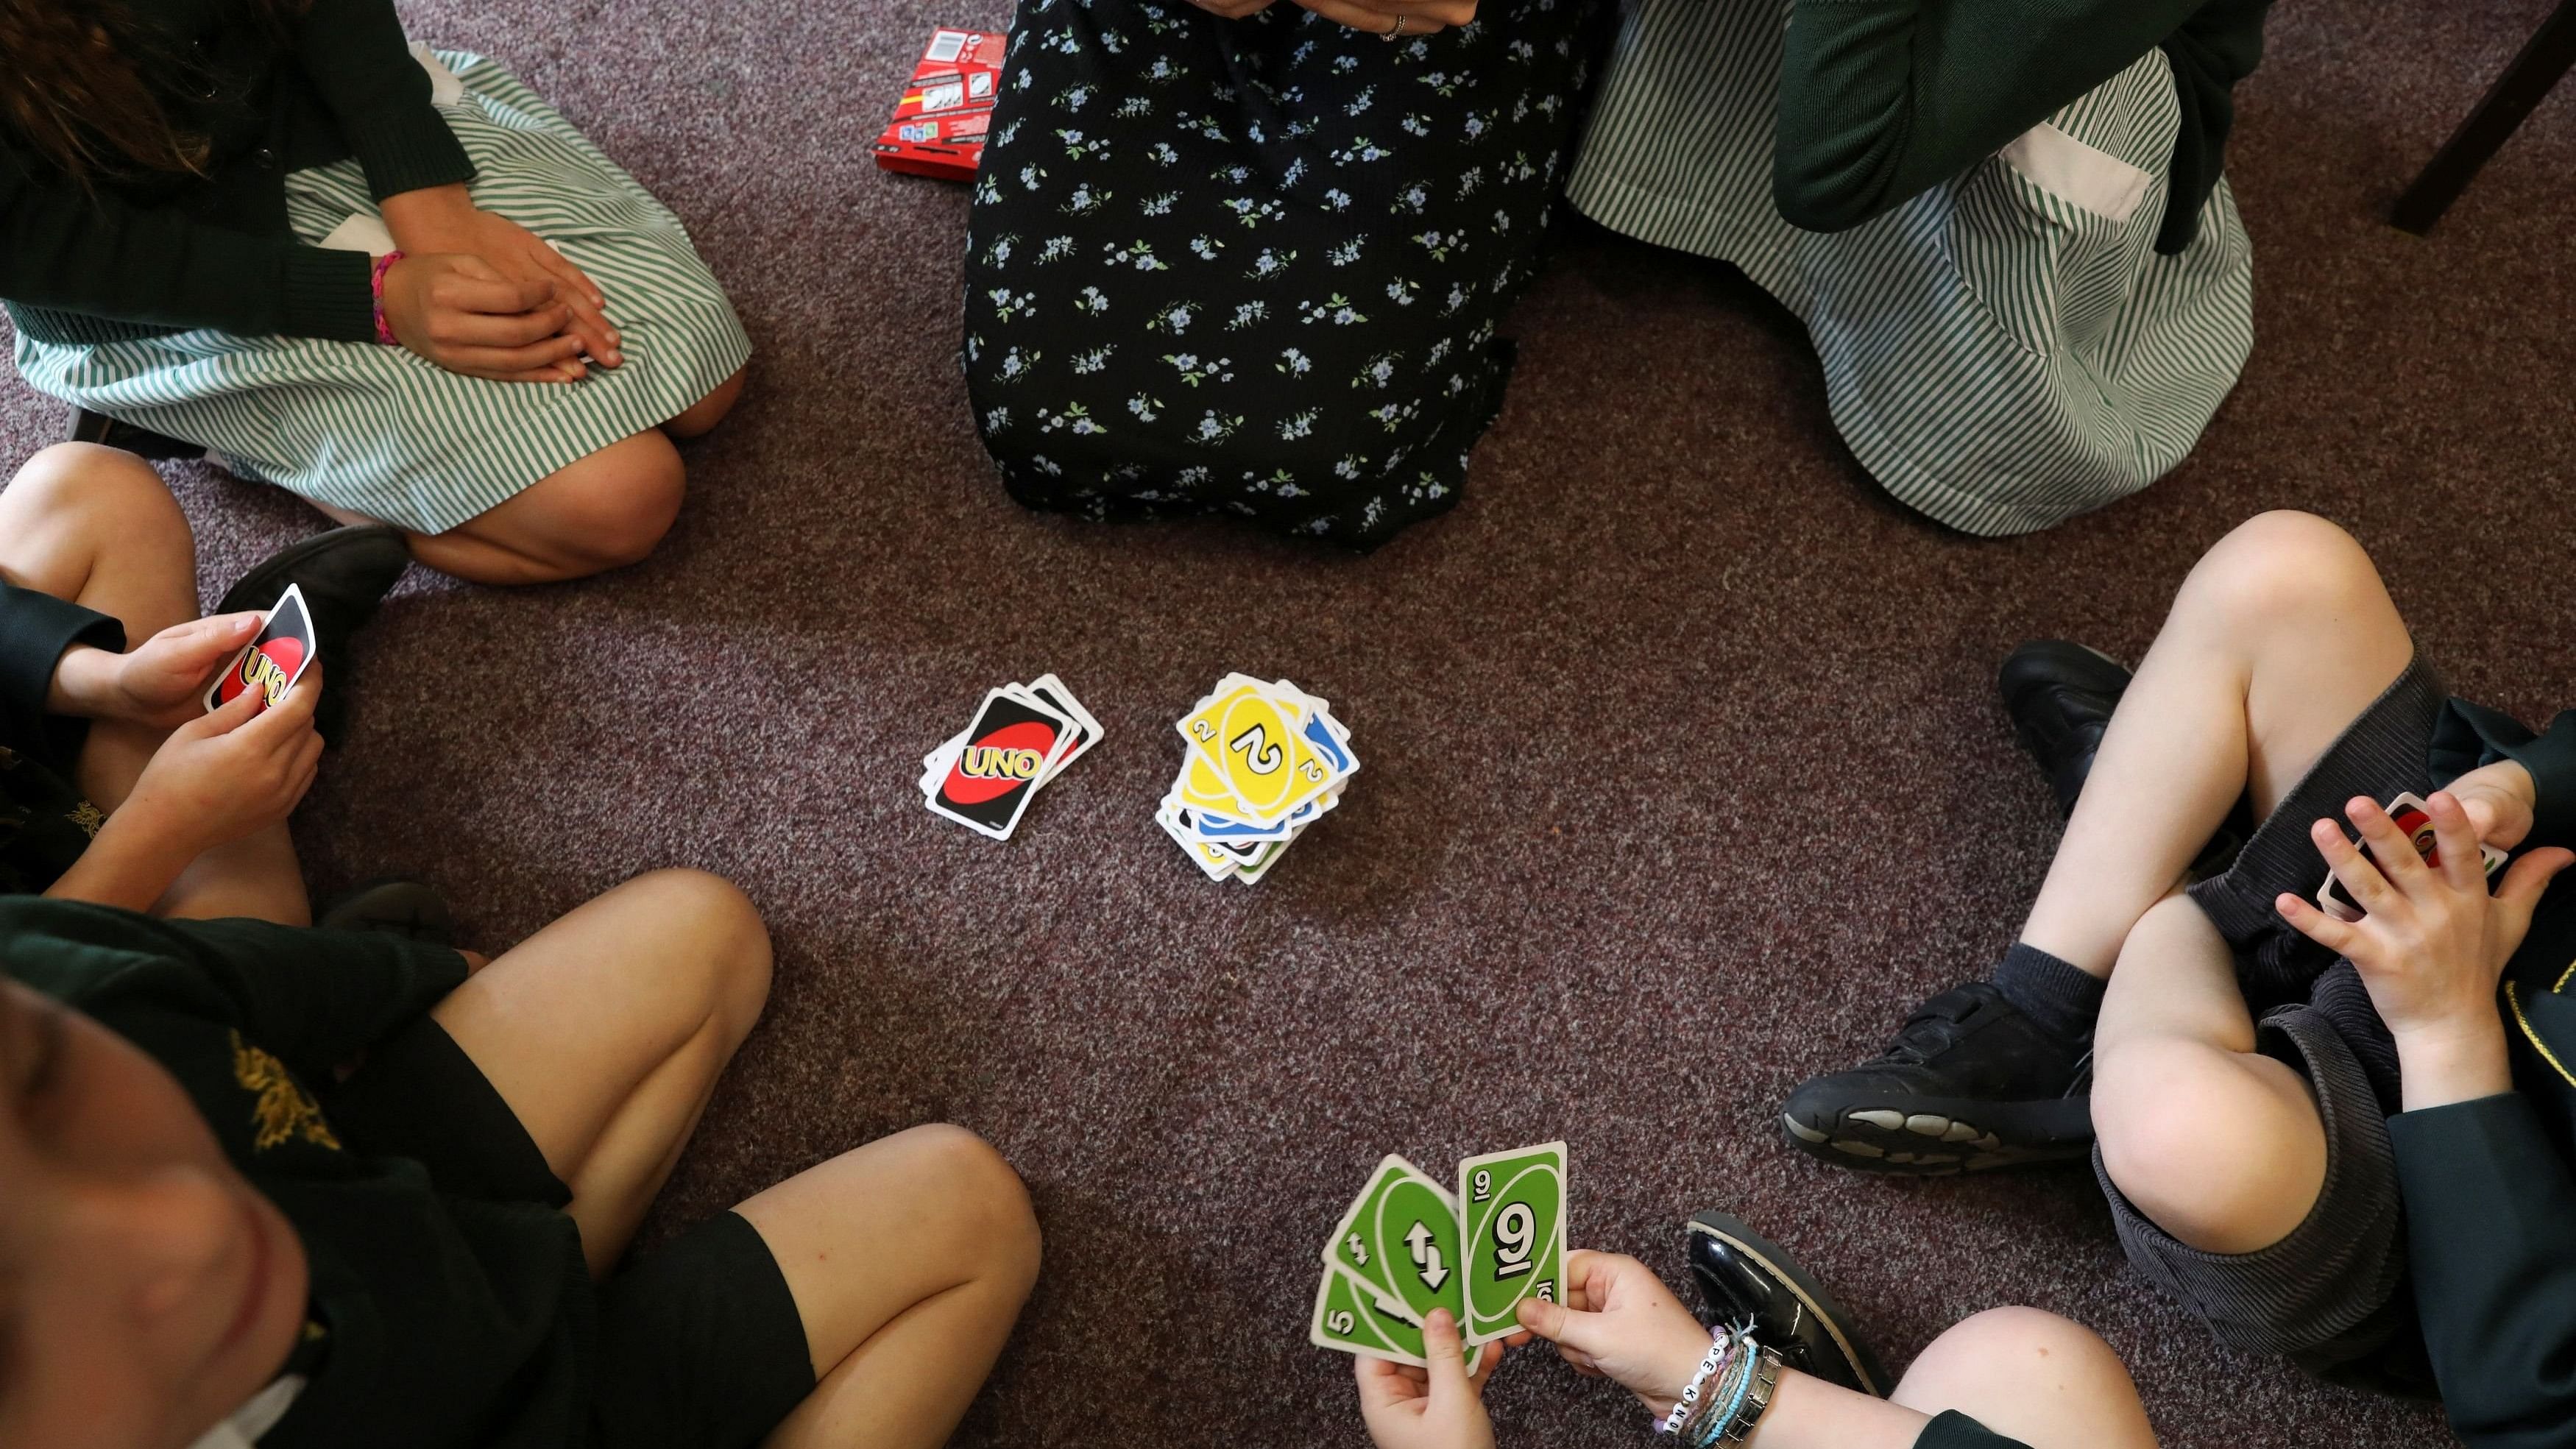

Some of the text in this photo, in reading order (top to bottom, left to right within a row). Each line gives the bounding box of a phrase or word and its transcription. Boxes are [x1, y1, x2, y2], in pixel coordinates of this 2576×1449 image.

[241, 646, 286, 707] UNO
[1193, 719, 1217, 743] 2
[960, 747, 1042, 779] UNO
[1231, 723, 1283, 775] 2
[1298, 758, 1323, 782] 2
[1472, 1170, 1492, 1203] 9
[1494, 1202, 1536, 1281] 9
[1326, 1309, 1355, 1336] 5
